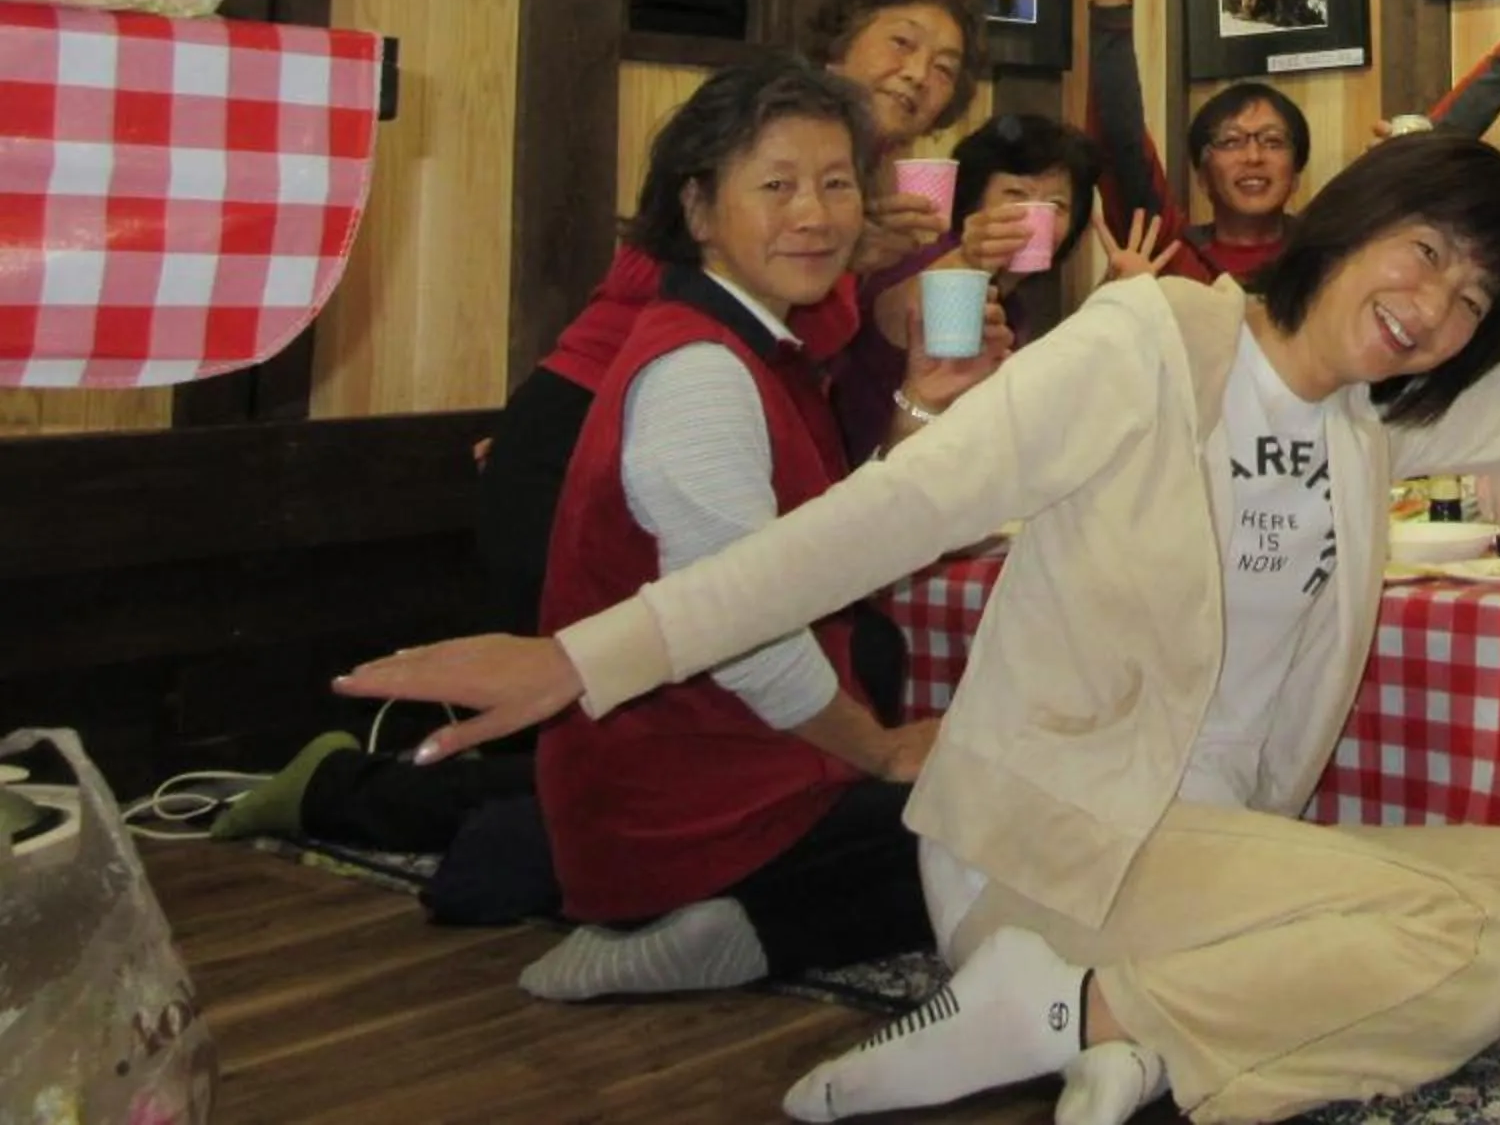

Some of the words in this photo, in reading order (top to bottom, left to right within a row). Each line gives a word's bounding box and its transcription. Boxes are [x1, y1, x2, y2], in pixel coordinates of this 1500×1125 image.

[1241, 509, 1299, 531] HERE
[1259, 533, 1279, 551] IS
[1238, 554, 1289, 572] NOW
